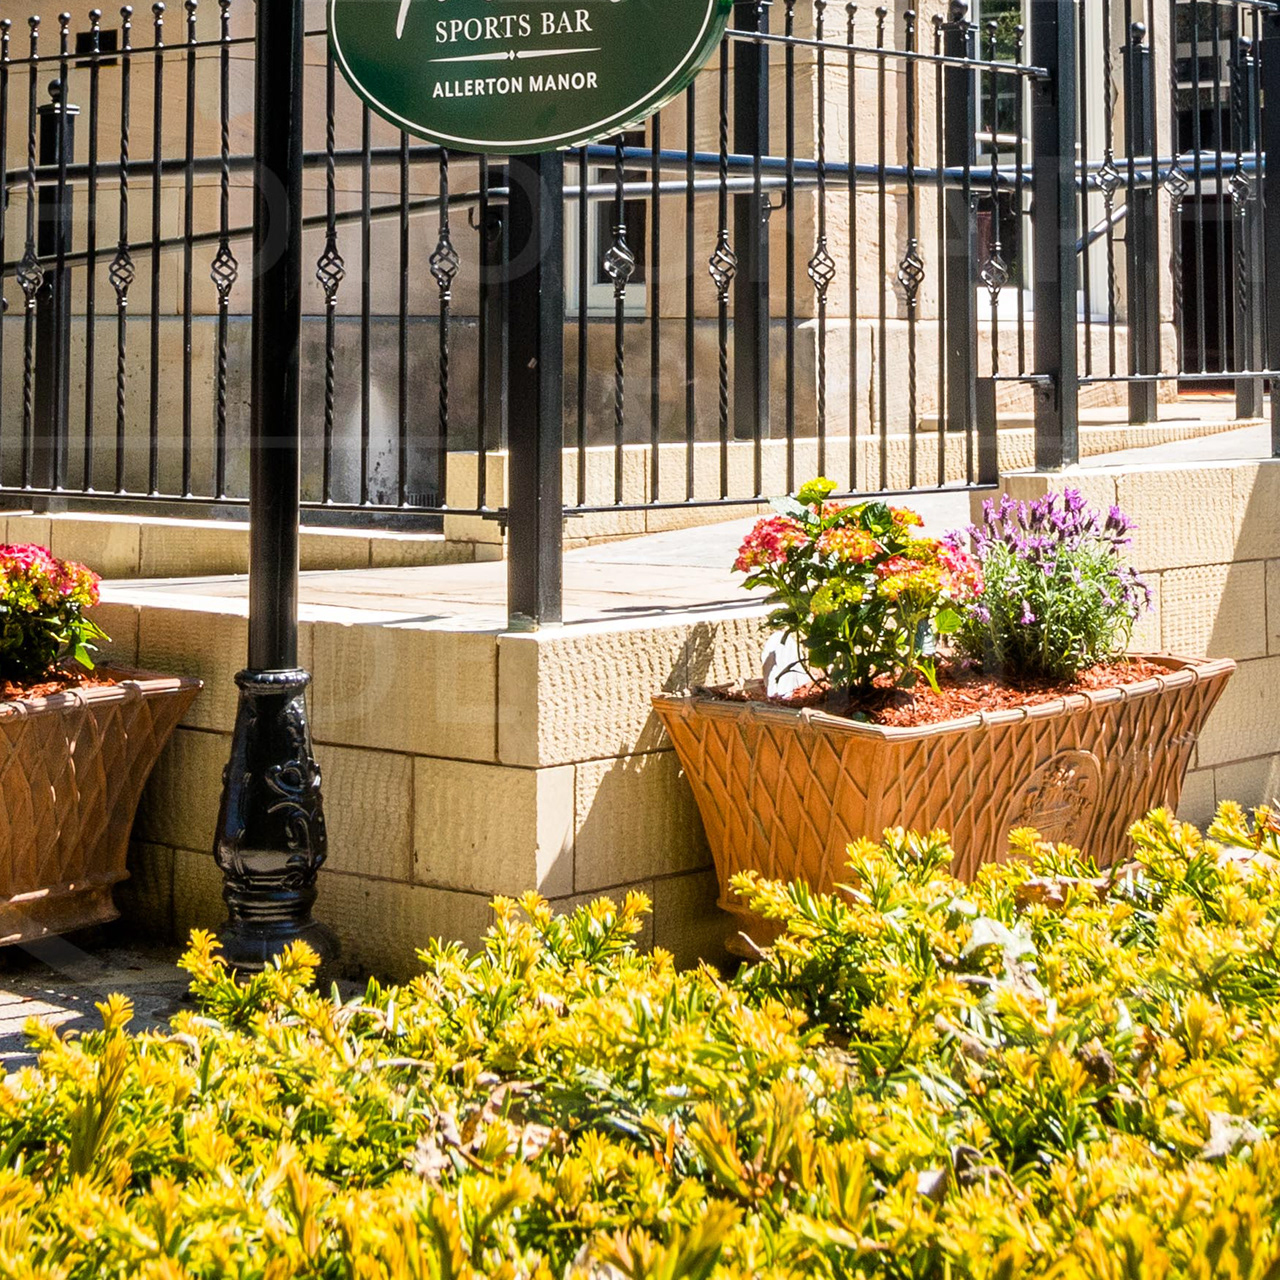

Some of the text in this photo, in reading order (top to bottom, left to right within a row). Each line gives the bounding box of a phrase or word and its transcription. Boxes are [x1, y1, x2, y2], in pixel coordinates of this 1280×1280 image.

[434, 9, 593, 44] SPORTS BAR
[432, 71, 599, 99] ALLERTON MANOR
